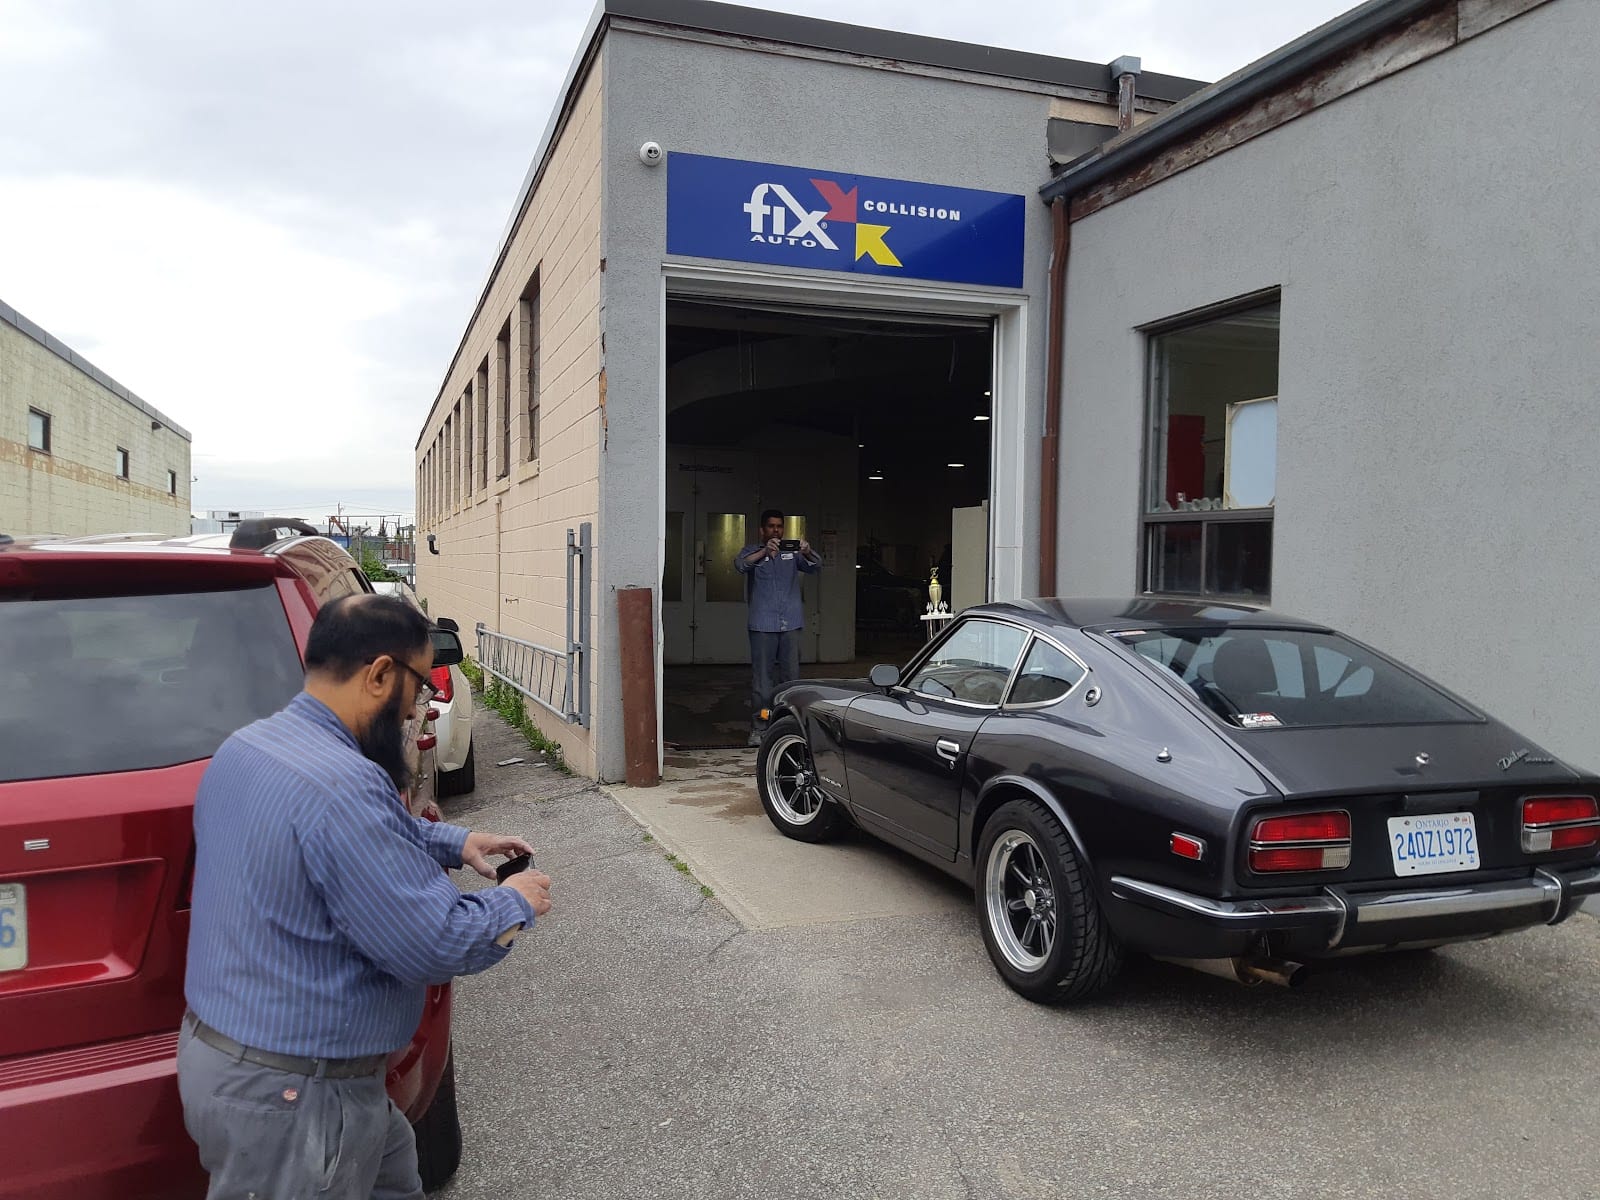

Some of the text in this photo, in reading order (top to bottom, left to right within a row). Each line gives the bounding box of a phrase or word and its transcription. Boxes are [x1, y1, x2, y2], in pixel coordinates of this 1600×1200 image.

[863, 200, 961, 221] COLLISION
[750, 234, 817, 248] AUTO
[1415, 819, 1450, 830] ONTARIO
[1395, 828, 1475, 861] 240Z1972
